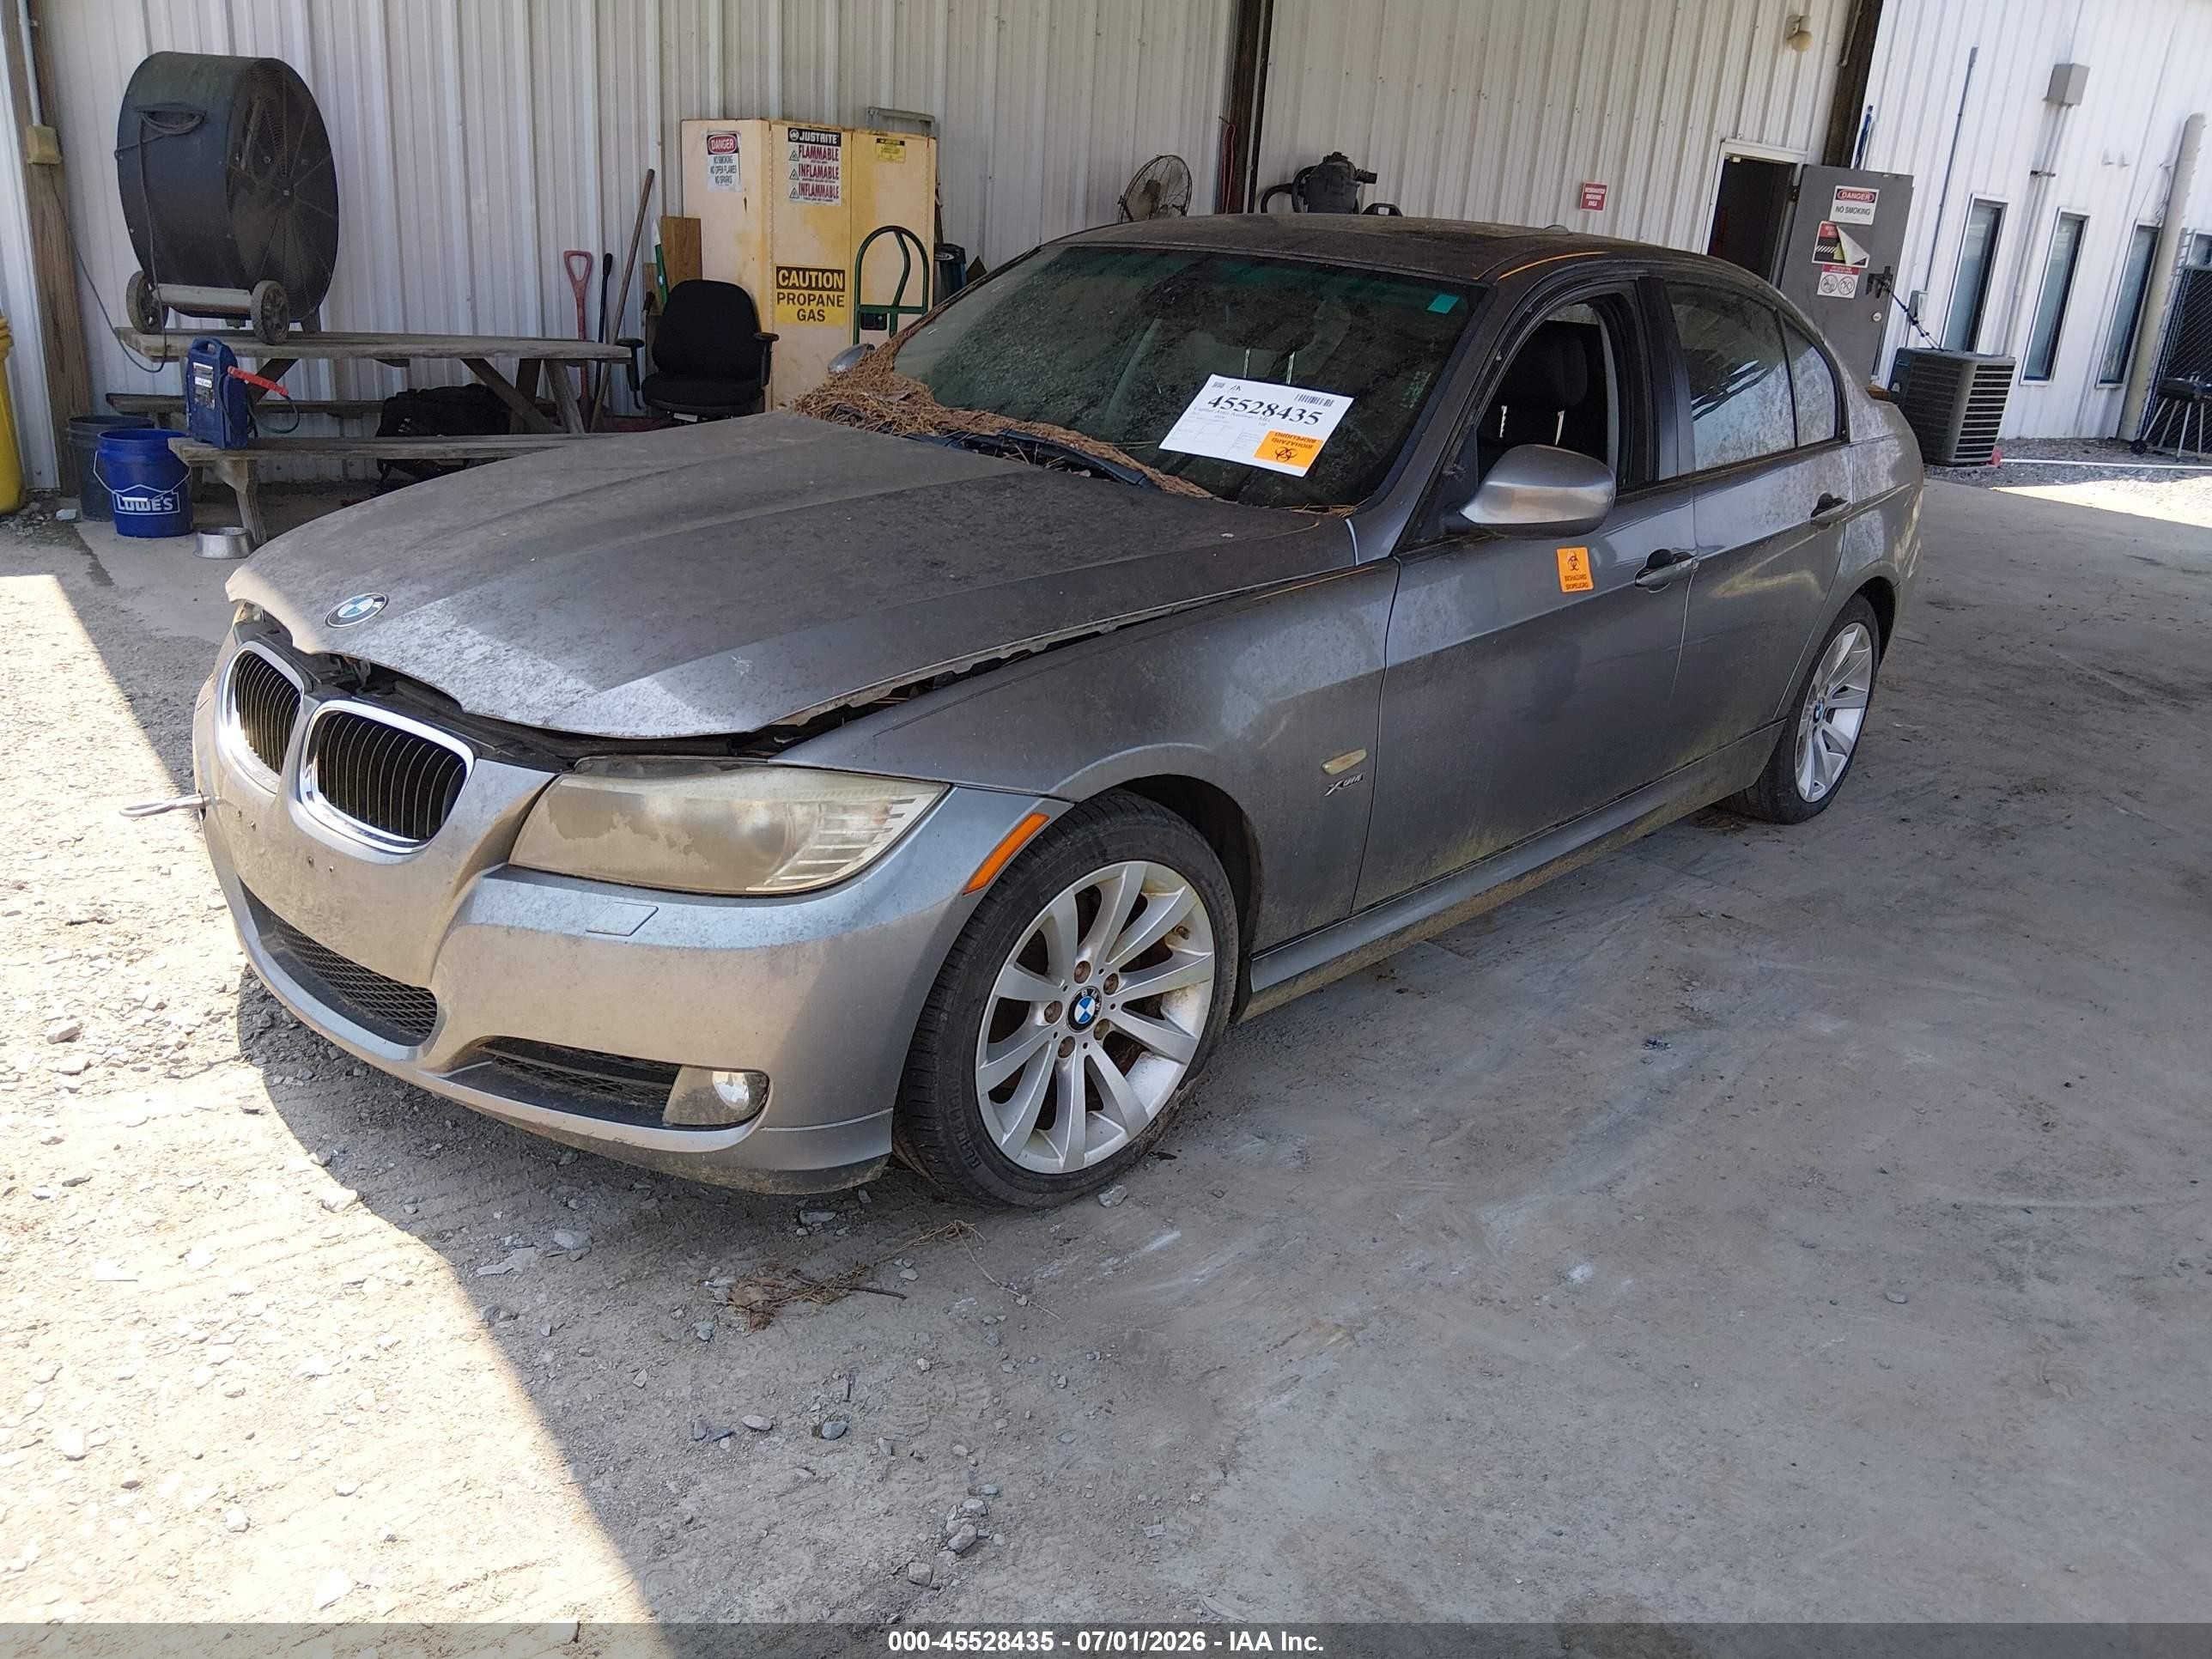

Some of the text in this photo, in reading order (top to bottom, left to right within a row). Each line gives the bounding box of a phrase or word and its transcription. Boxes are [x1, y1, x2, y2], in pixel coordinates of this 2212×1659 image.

[711, 138, 734, 150] DANGER
[799, 131, 838, 144] JUSTRITE
[799, 144, 839, 161] FLAMMABLE
[799, 163, 839, 179] INFLAMABLE
[799, 182, 839, 199] INFLAMMABLE
[1841, 191, 1871, 201] DANGER
[1835, 205, 1871, 216] NO SMOKING
[778, 269, 844, 289] CAUTION
[777, 292, 845, 307] PROPANE
[797, 309, 826, 322] GAS
[1207, 394, 1323, 425] 45528435
[1271, 437, 1313, 450] BIOHAZARD
[116, 495, 173, 511] LOWE'S
